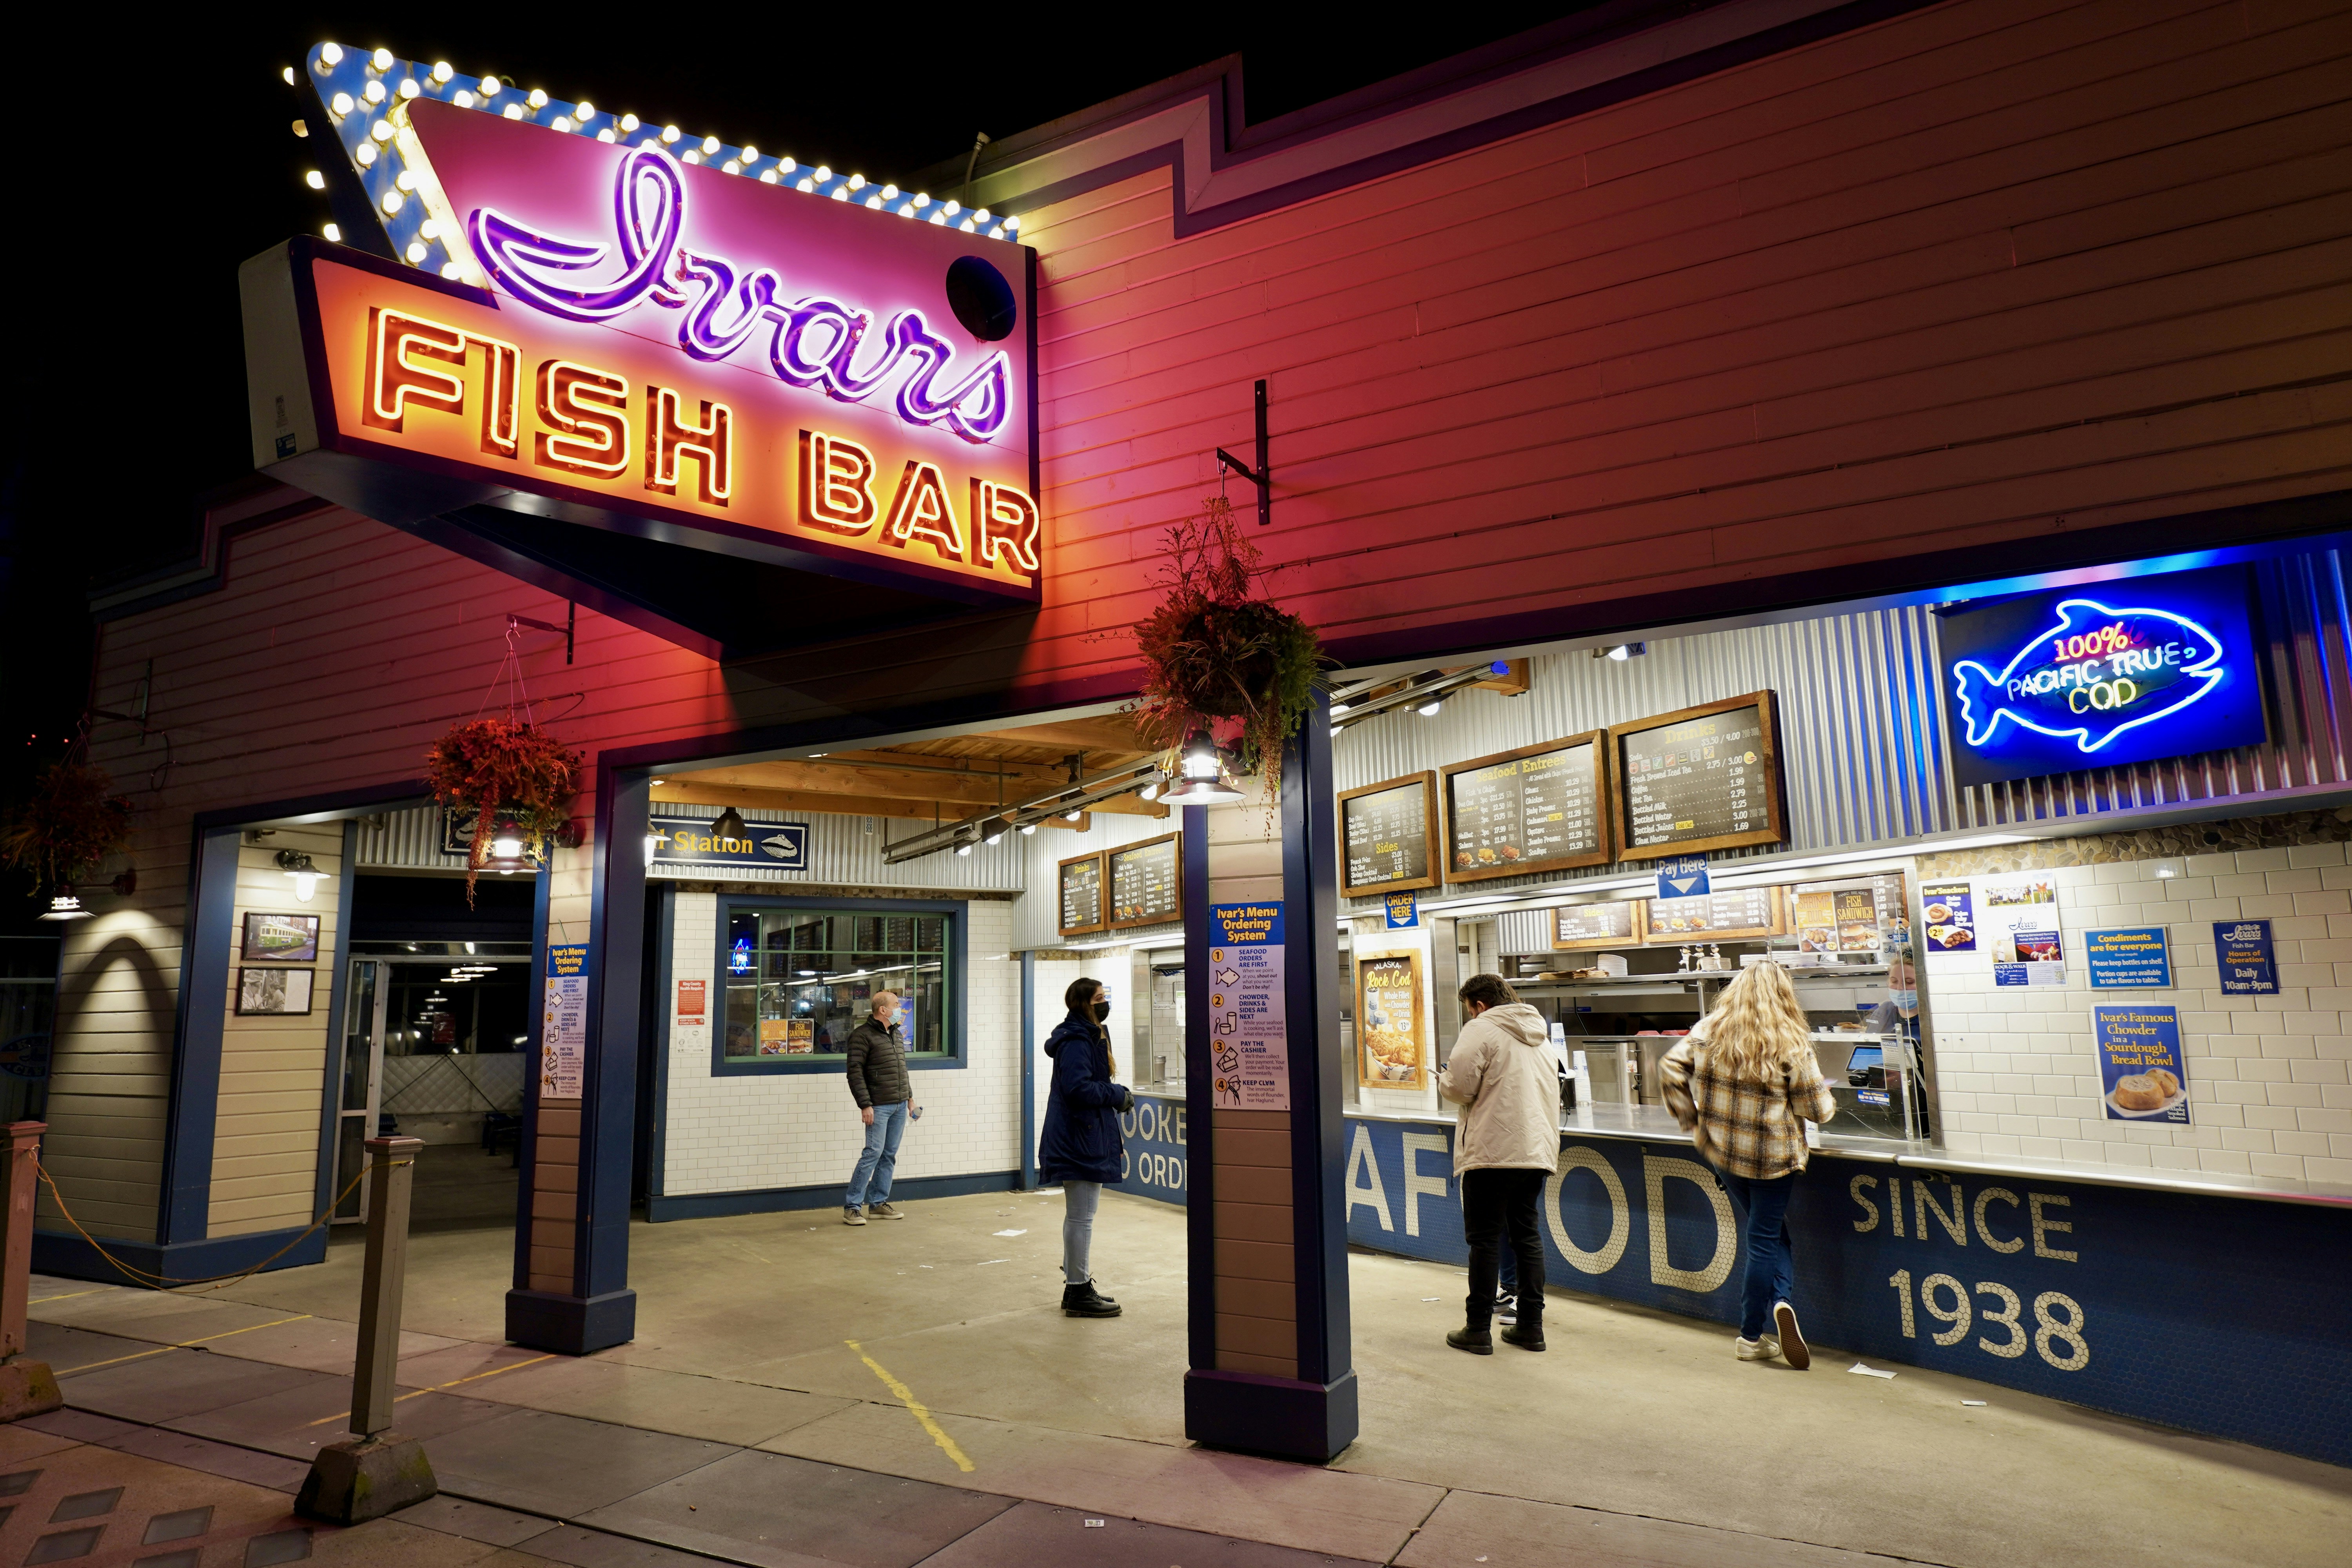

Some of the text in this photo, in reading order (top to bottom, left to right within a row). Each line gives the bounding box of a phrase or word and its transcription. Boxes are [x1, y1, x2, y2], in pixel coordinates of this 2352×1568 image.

[362, 306, 1040, 576] FISH BAR
[2054, 622, 2127, 662] 100%
[2007, 642, 2180, 701] PACIFIC TRUE
[2069, 678, 2136, 714] COD
[1664, 723, 1716, 744] Drinks
[1629, 731, 1740, 762] Soda $3.50 4.00
[1475, 755, 1566, 783] Seafood Entrees
[1630, 774, 1646, 784] Fresh
[1646, 770, 1666, 781] Brewed
[1667, 767, 1681, 777] Iced
[1706, 759, 1720, 769] 2.75
[1728, 755, 1742, 765] 3.00
[1525, 778, 1579, 795] Clams 10.29
[1631, 766, 1744, 794] Coffee 1.99
[1730, 777, 1744, 787] 1.99
[1365, 790, 1404, 807] Chowder
[1526, 788, 1580, 805] Chicken 10.29
[1632, 789, 1745, 815] Bottled Milk 2.79
[1633, 799, 1746, 825] Bottled Water 2.25
[1634, 811, 1748, 835] Bottled Juices 3.00
[1635, 822, 1749, 845] Clam Nectar 1.69
[675, 831, 753, 854] Station
[1376, 842, 1398, 854] Sides
[1659, 857, 1705, 878] Pay Here
[1387, 893, 1414, 906] ORDER
[1799, 894, 1829, 909] SHRIMP
[1846, 895, 1862, 907] FISH
[1217, 906, 1278, 919] Ivar's Menu
[1391, 906, 1412, 918] HERE
[1807, 909, 1822, 922] DUO
[1837, 907, 1874, 920] SANDWICH
[1223, 918, 1271, 931] Ordering
[1227, 931, 1266, 944] System
[2098, 934, 2151, 942] Condiments
[553, 948, 568, 956] Ivar's
[2120, 943, 2162, 951] everyone
[555, 956, 582, 965] Ordering
[1376, 961, 1400, 971] ALASKA
[557, 966, 579, 975] System
[2235, 968, 2258, 979] Daily
[1367, 970, 1411, 988] Rock Cod
[2225, 980, 2272, 991] 10am-9pm
[1215, 996, 1221, 1005] 2
[1384, 991, 1410, 1000] Whole Fillet
[1391, 1000, 1410, 1009] Chowder
[1398, 1009, 1410, 1018] Drink
[2100, 1013, 2174, 1023] Ivar's Famous
[2107, 1023, 2157, 1035] Chowder
[2105, 1041, 2167, 1056] Sourdough
[2111, 1054, 2174, 1065] Bread Bowl
[1218, 1081, 1224, 1089] 4
[1121, 1103, 1186, 1145] OOKE
[1138, 1152, 1187, 1191] ORD
[1346, 1125, 1737, 1293] AFOD
[1849, 1174, 2078, 1262] SINCE
[1889, 1269, 2090, 1371] 1938
